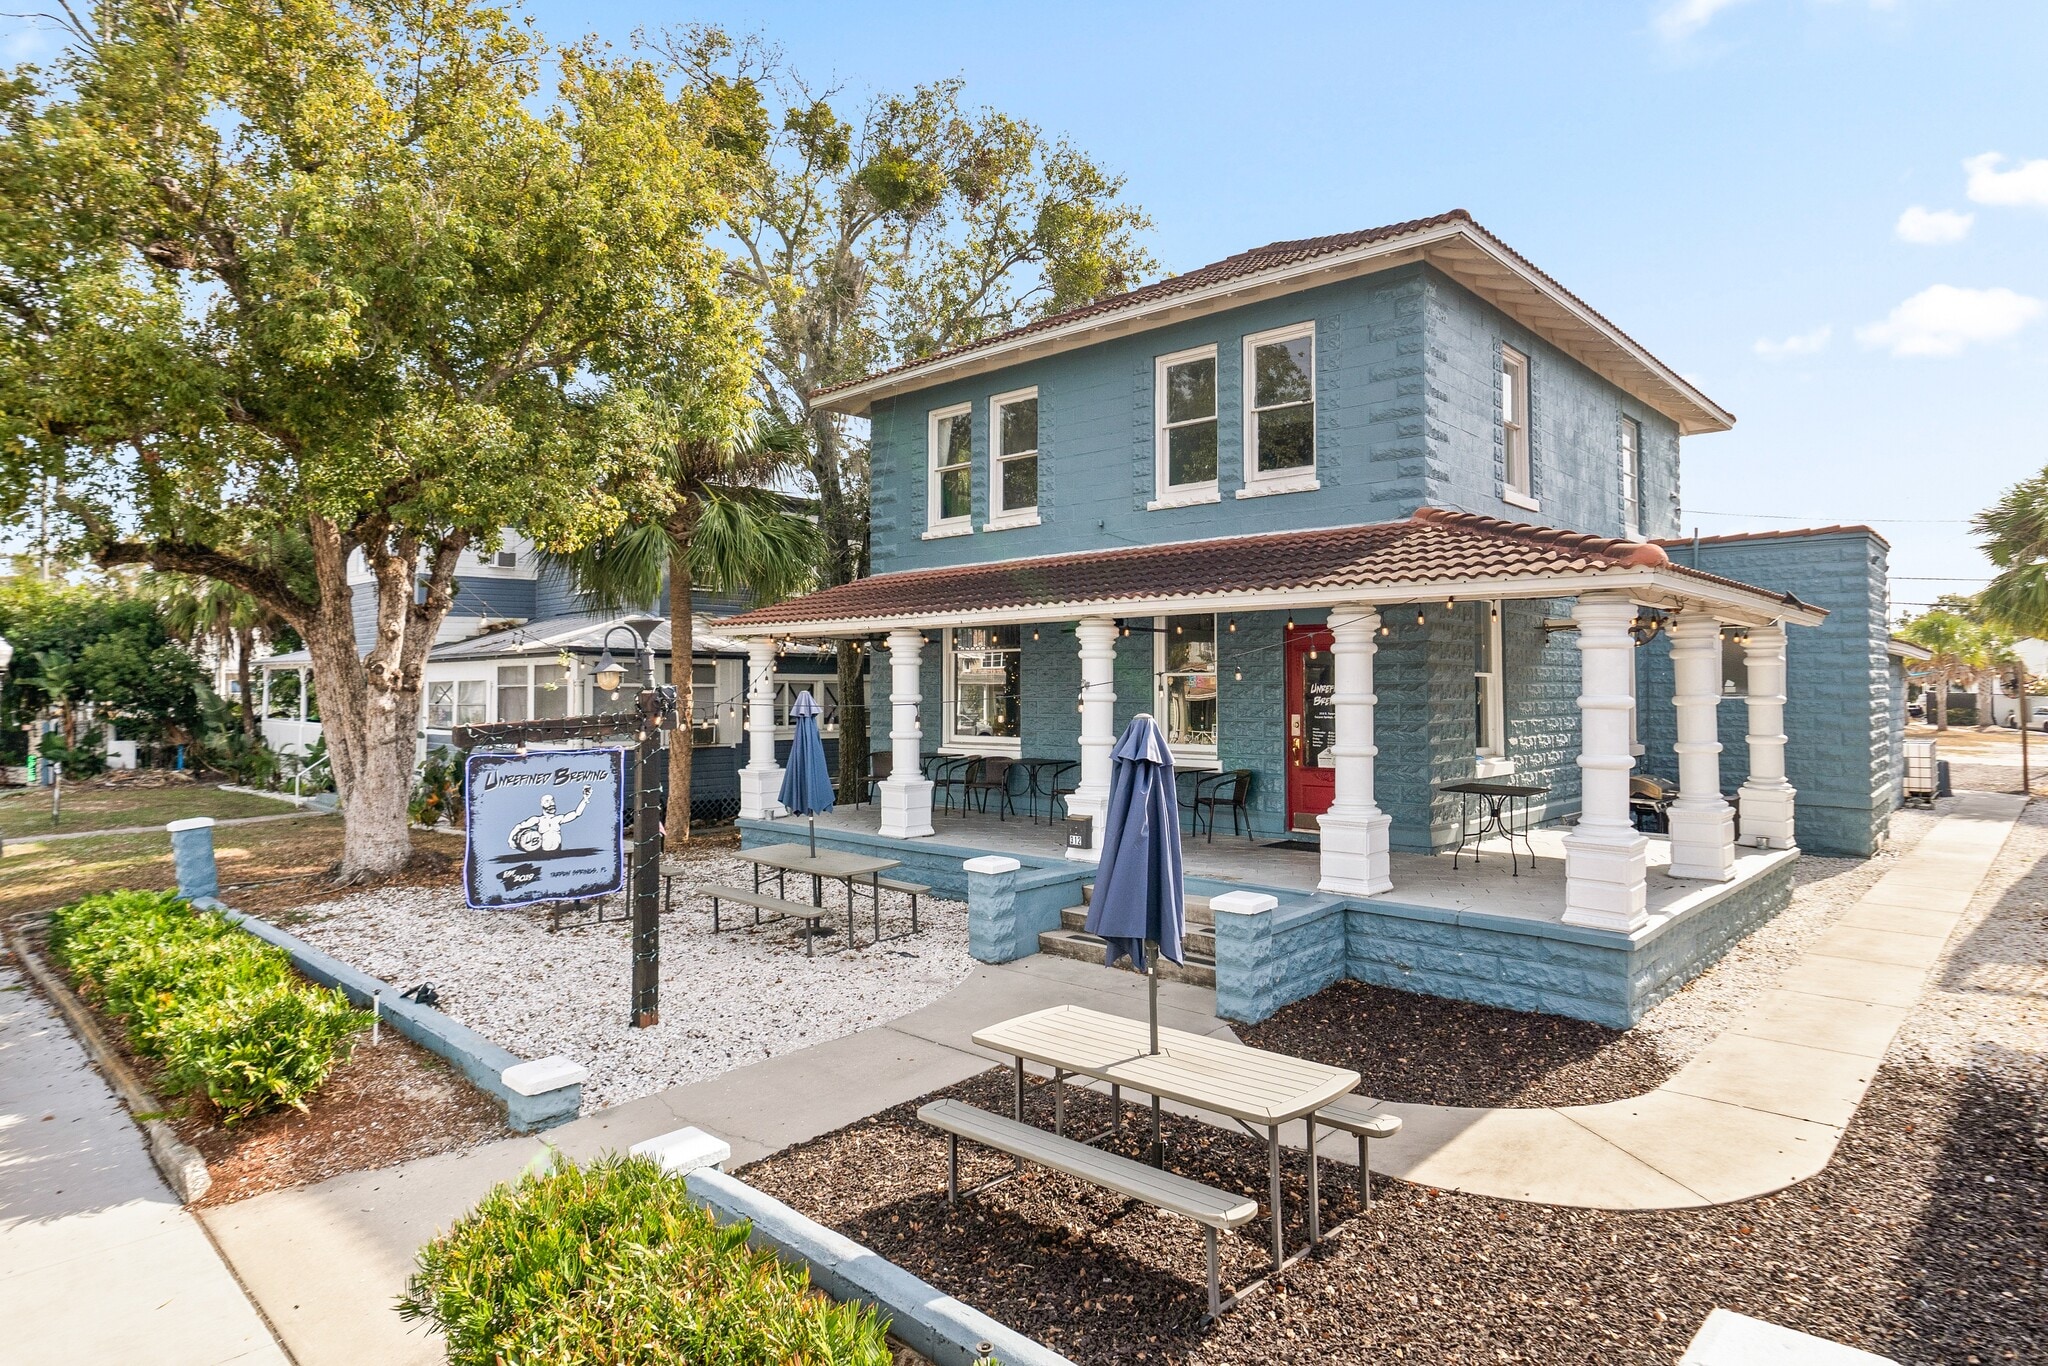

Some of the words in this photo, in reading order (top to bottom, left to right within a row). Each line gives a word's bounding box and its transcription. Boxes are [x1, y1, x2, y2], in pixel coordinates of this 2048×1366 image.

[484, 770, 553, 792] UNREFINED
[553, 767, 608, 786] BREWING
[1070, 836, 1081, 845] 312
[513, 873, 535, 882] 2019
